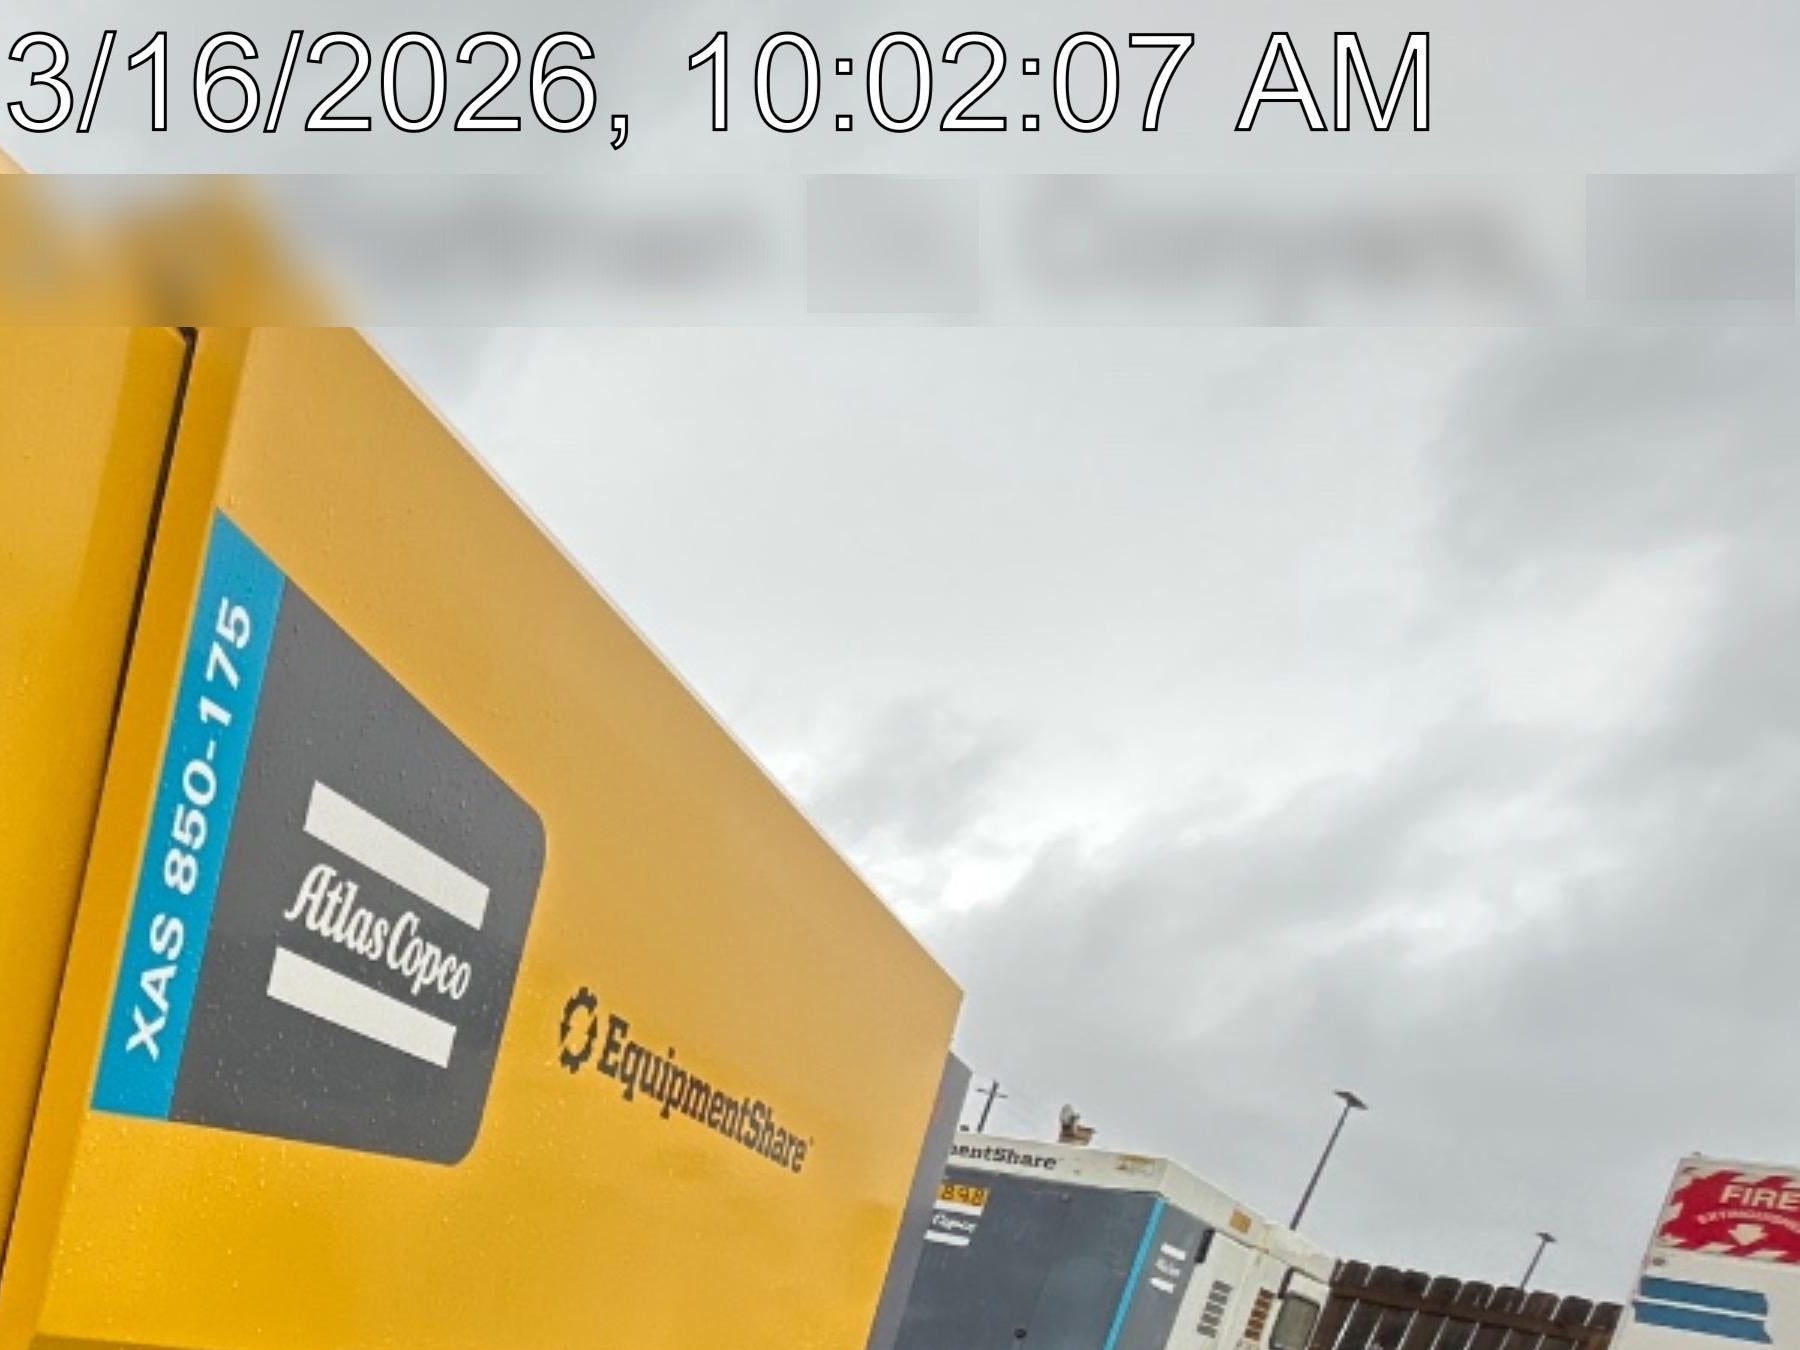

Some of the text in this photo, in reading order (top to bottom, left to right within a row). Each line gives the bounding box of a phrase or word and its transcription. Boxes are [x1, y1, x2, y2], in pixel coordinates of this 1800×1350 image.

[126, 598, 253, 1058] XAS 850-175
[596, 1013, 808, 1173] EquipmentShare
[1719, 1184, 1800, 1212] FIRE
